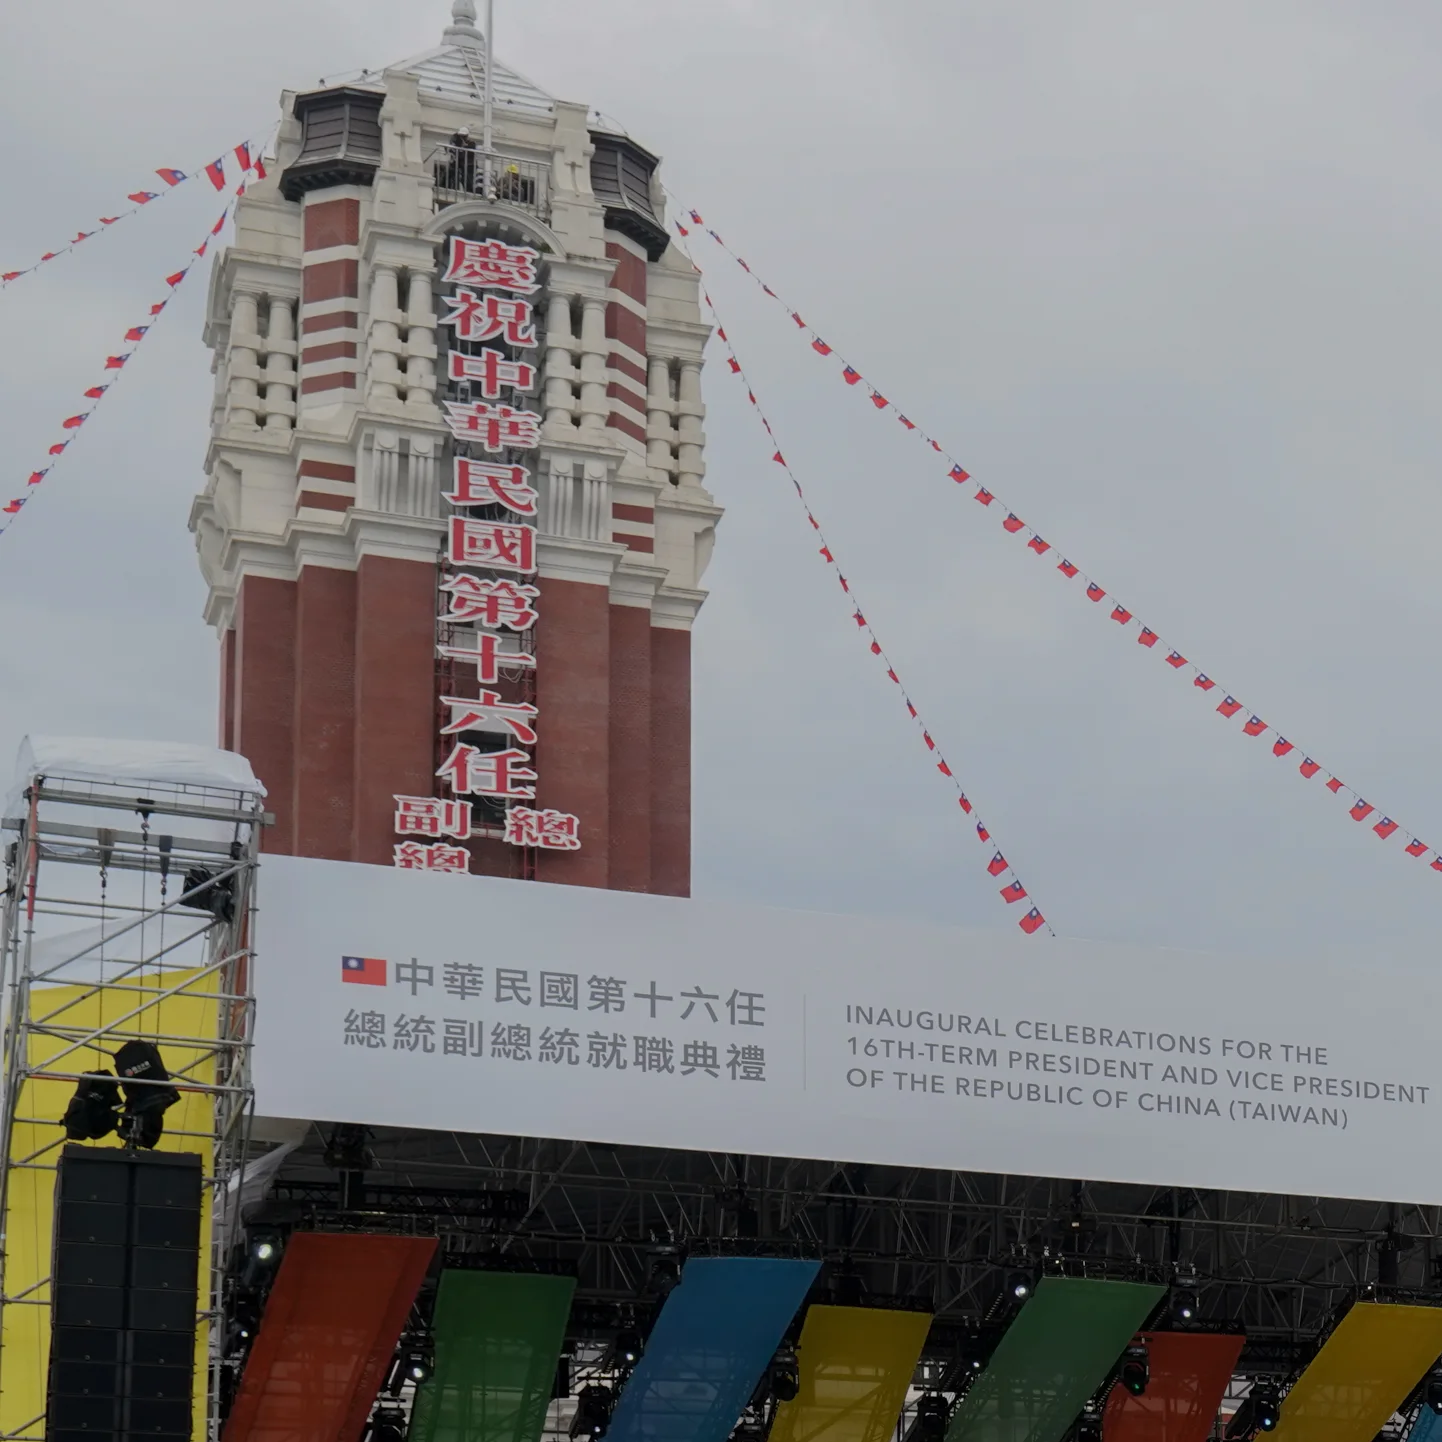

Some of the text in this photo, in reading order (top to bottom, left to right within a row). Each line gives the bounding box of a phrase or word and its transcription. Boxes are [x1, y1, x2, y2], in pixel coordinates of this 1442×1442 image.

[437, 235, 543, 801] 慶祝中華民國第十六任
[504, 805, 581, 850] 總
[395, 957, 766, 1027] 中華民國第十六任
[343, 1008, 766, 1082] 總統副總統就職典禮
[847, 1005, 1327, 1065] INAUGURAL CELEBRATIONS FOR THE
[847, 1068, 1347, 1129] OF THE REPUBLIC OF CHINA (TAIWAN)
[848, 1037, 1429, 1104] 16TH-TERM PRESIDENT AND VICE PRESIDENT
